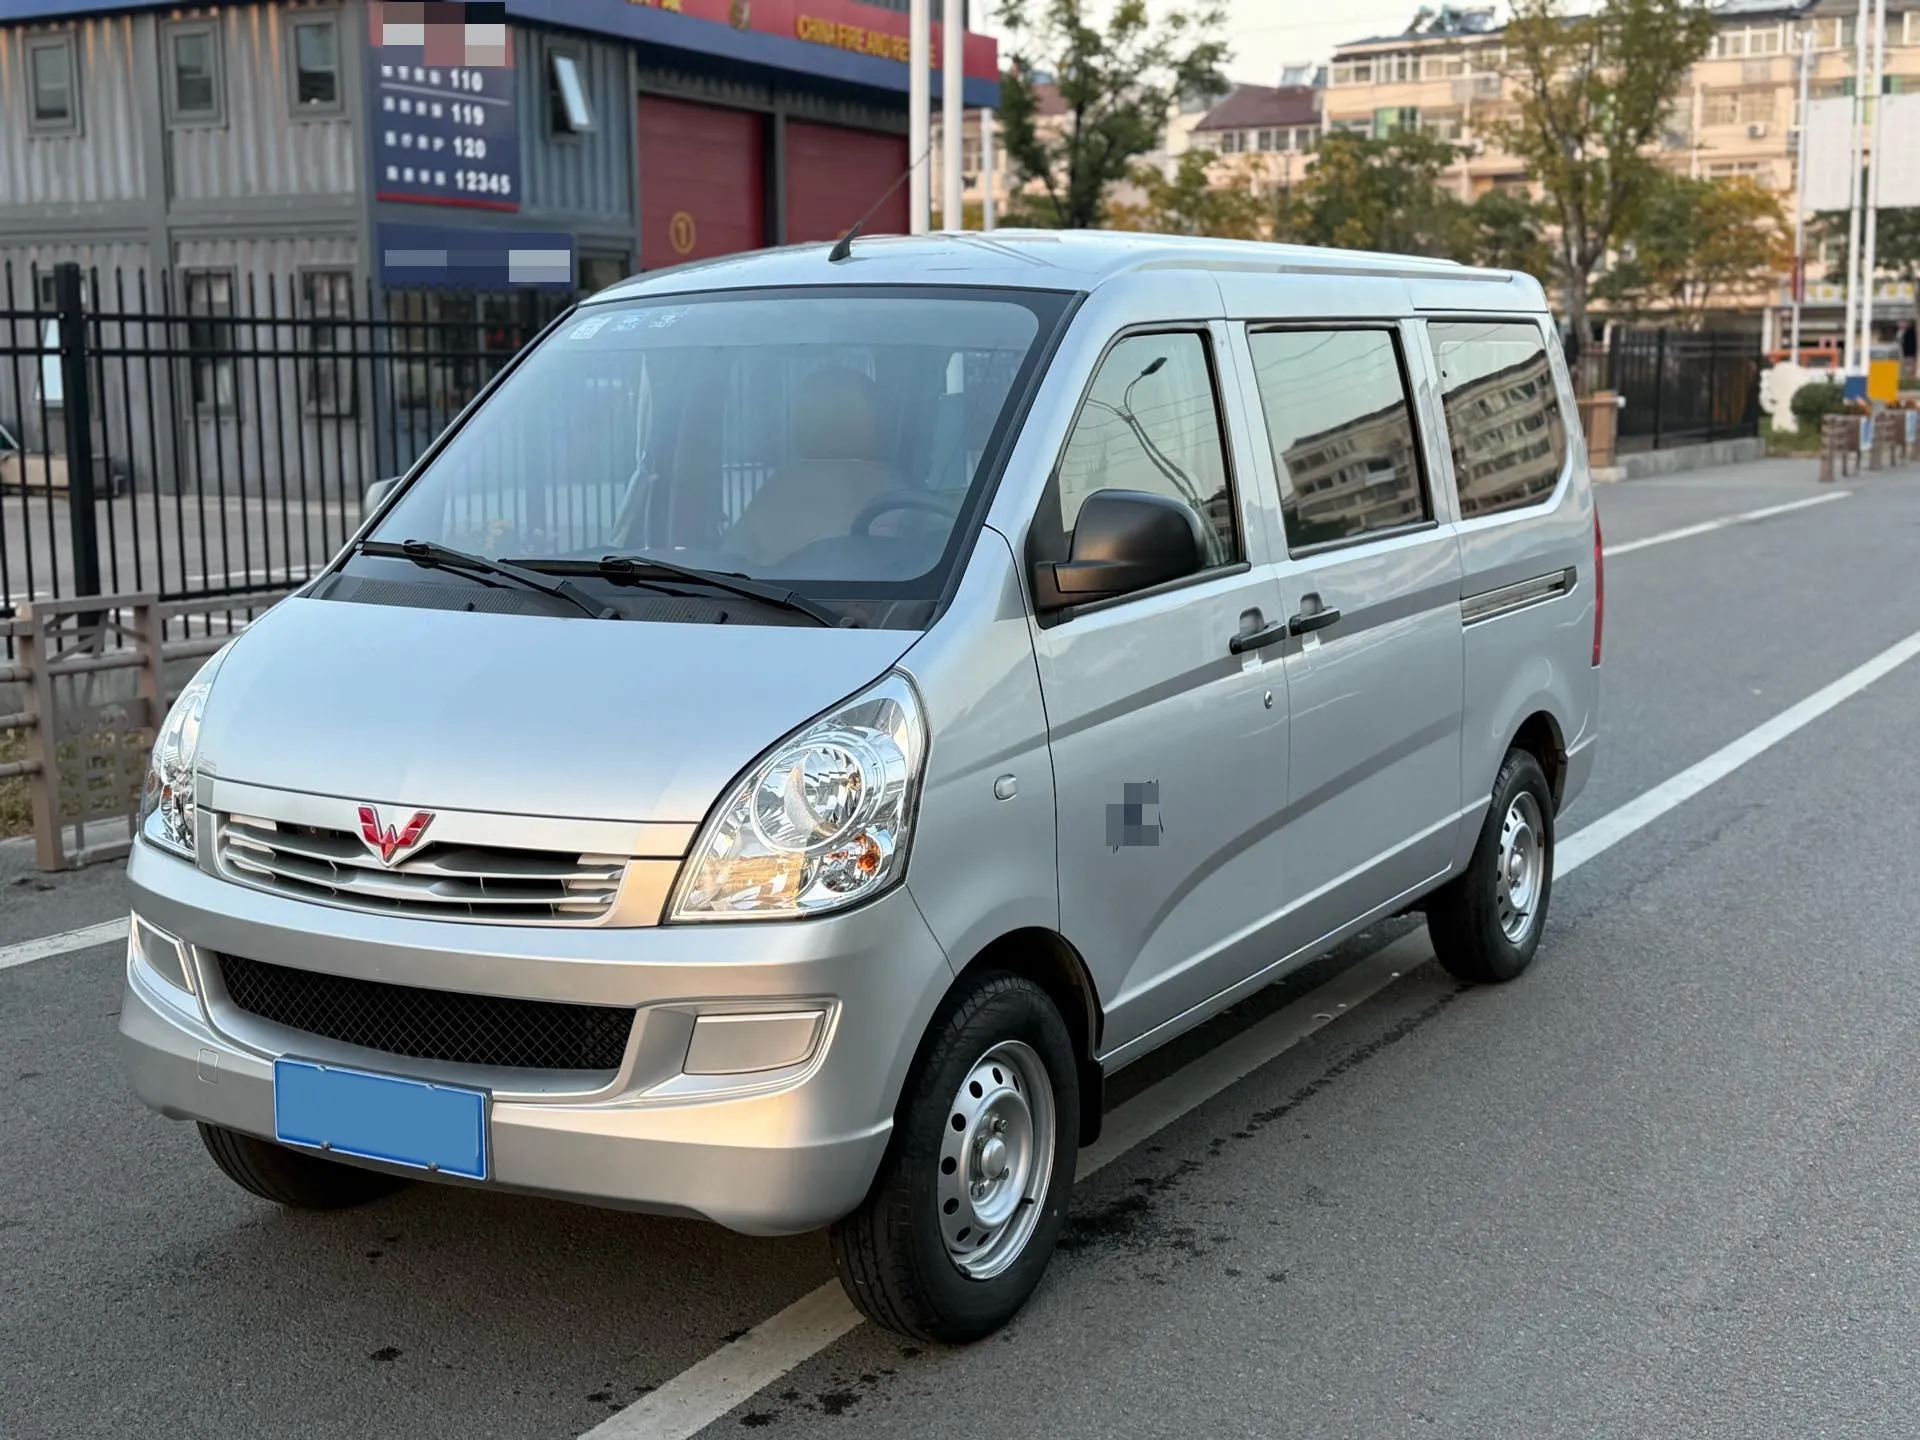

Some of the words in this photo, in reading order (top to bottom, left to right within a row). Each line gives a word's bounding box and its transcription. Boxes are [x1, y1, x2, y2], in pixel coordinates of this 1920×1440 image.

[450, 69, 483, 92] 110
[451, 102, 485, 126] 119
[453, 135, 487, 159] 120
[455, 169, 512, 195] 12345
